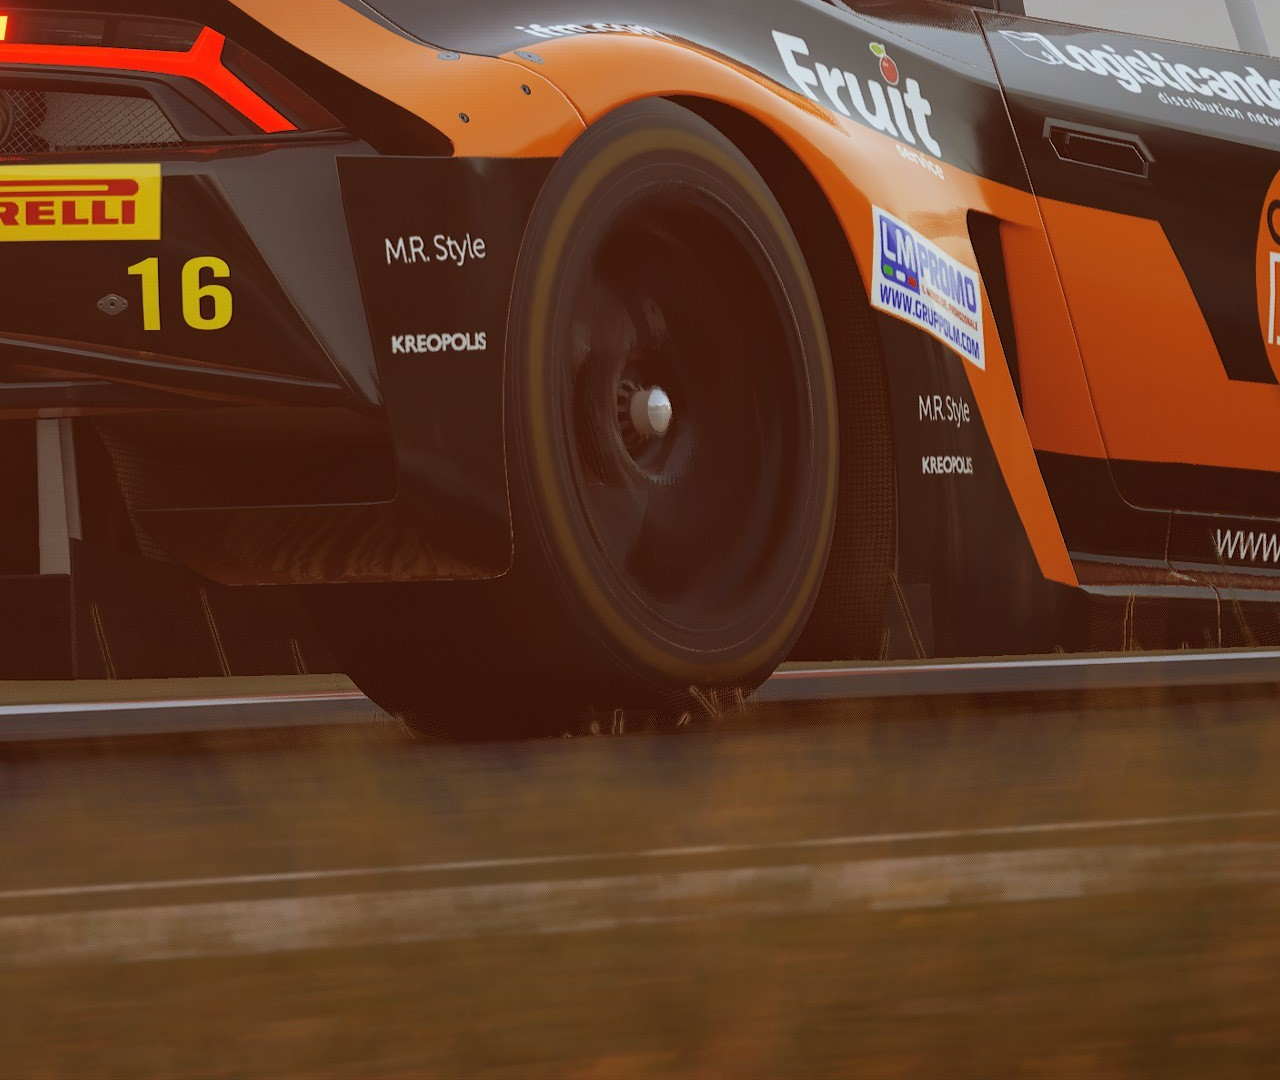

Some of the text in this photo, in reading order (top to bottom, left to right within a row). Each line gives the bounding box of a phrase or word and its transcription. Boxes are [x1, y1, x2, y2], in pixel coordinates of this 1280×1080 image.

[771, 29, 942, 158] Fruit
[1158, 92, 1244, 121] distribution
[895, 144, 945, 180] service
[385, 232, 486, 266] M.R. Style
[127, 256, 233, 331] 16
[880, 283, 980, 360] WWW.GRUPPOLM.COM
[391, 331, 487, 354] KREOPOLIS
[919, 394, 970, 428] M.R. Style
[922, 455, 973, 475] KREOPOLIS
